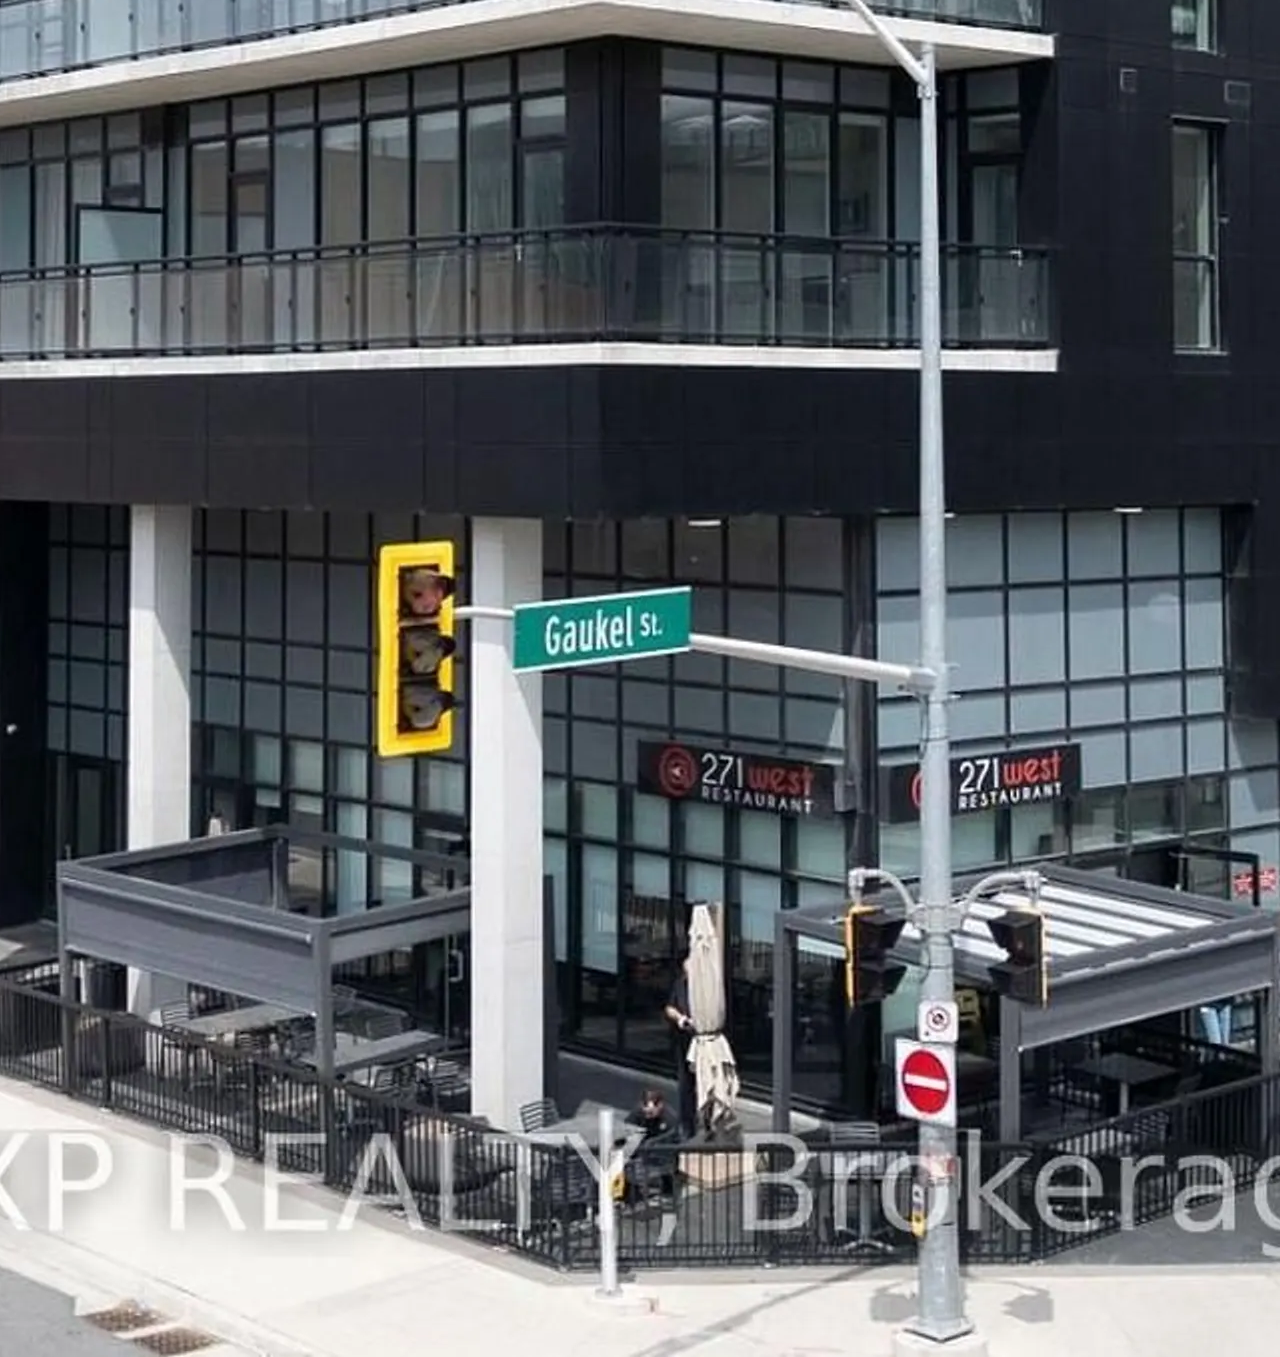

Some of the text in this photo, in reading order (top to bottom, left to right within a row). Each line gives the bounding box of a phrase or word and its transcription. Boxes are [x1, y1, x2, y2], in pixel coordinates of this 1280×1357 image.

[545, 605, 663, 656] Gaukel St.
[701, 785, 814, 815] RESTAURANT
[958, 782, 1063, 810] RESTAURANT
